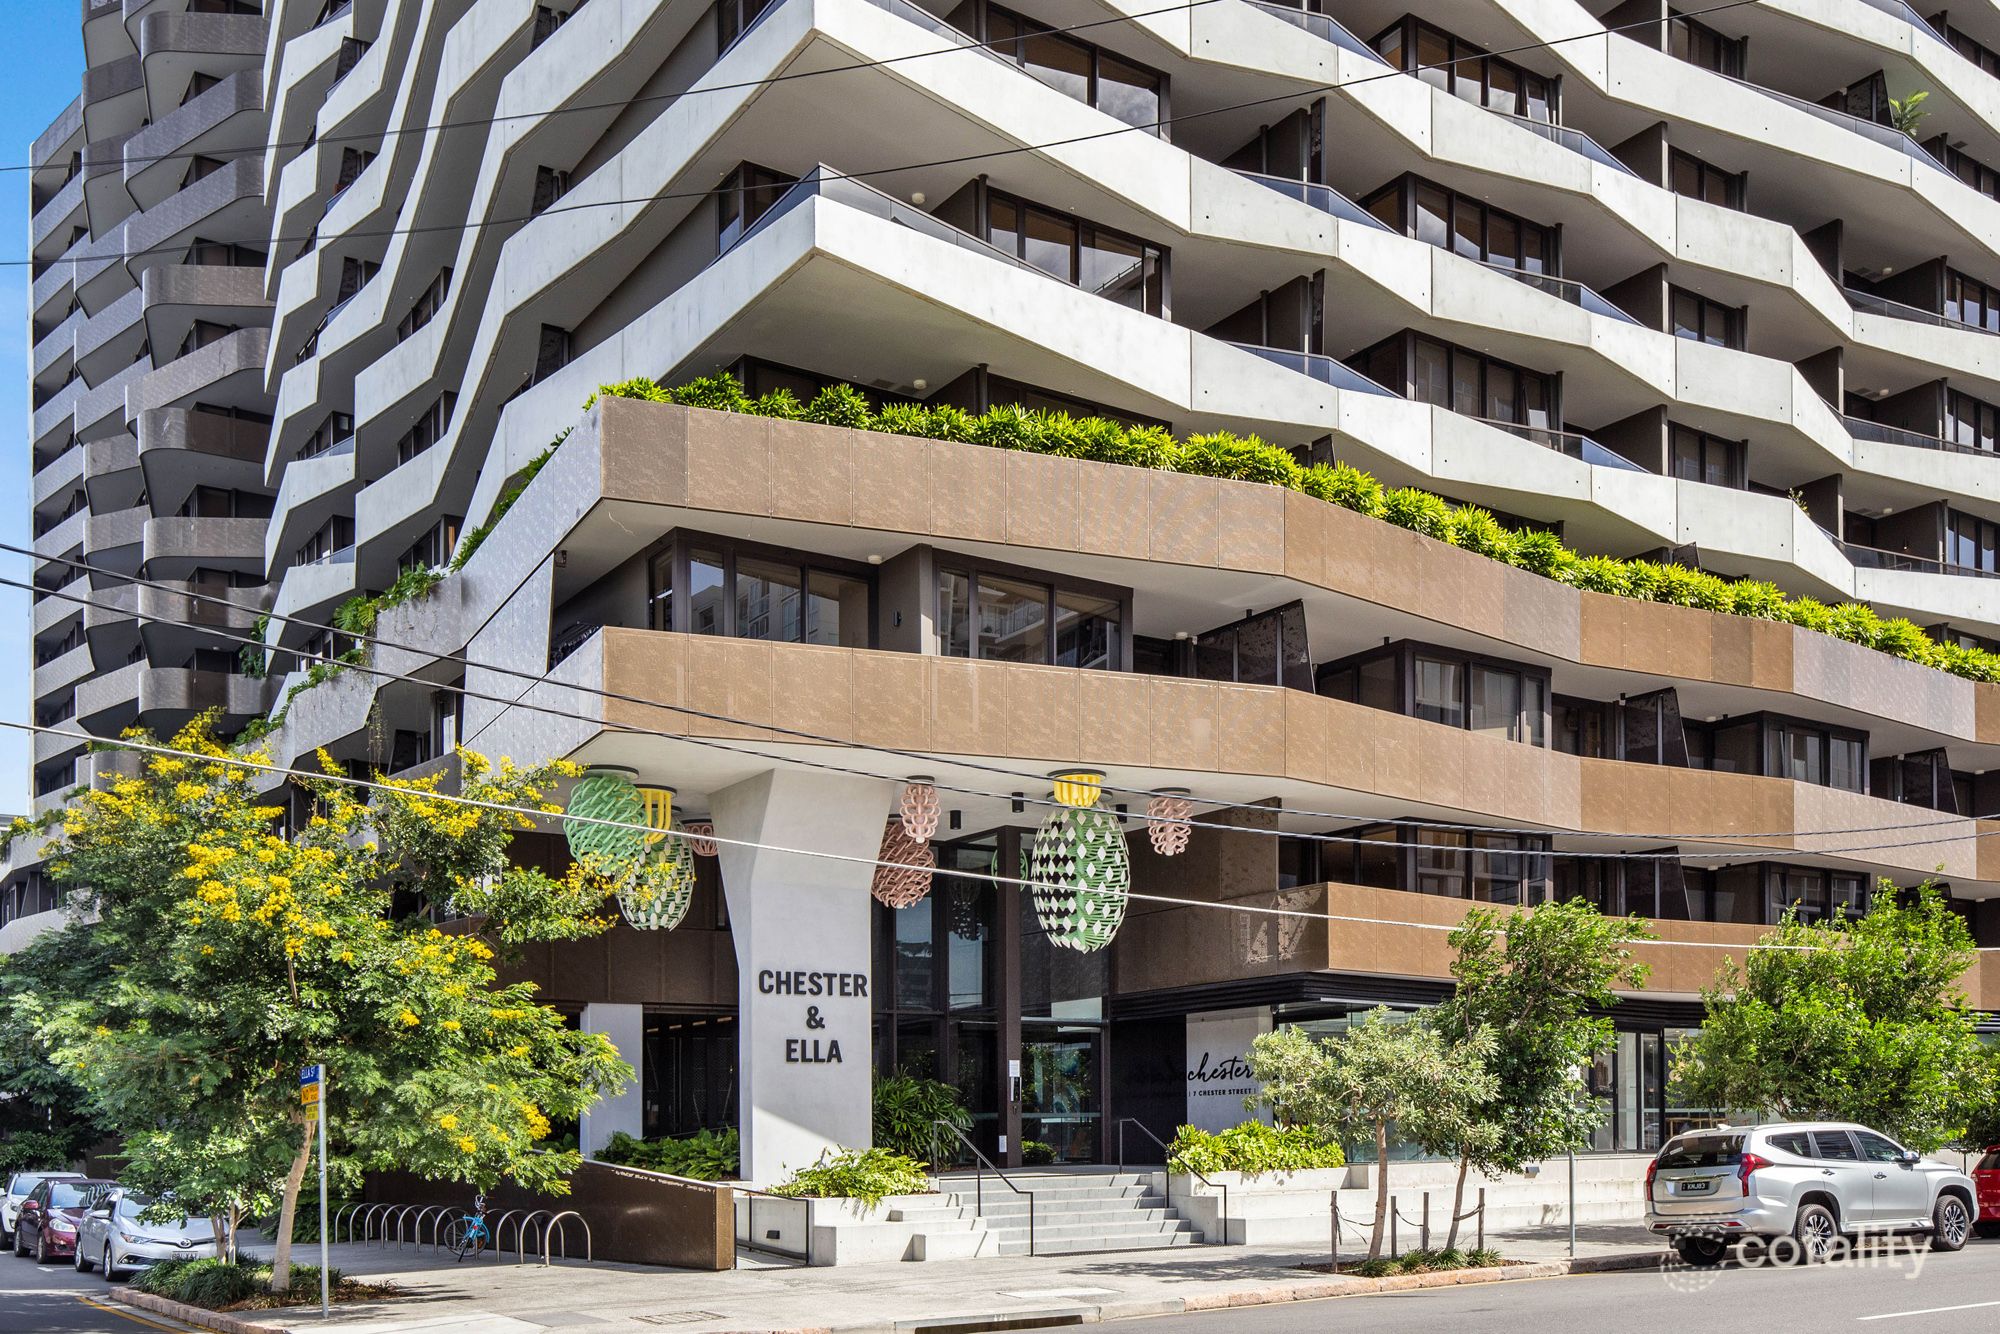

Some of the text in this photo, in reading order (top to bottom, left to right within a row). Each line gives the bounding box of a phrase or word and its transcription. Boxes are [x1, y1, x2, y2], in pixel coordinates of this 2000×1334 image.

[758, 969, 868, 997] CHESTER
[805, 1005, 826, 1030] &
[785, 1038, 843, 1063] ELLA
[1187, 1051, 1254, 1083] chester
[1198, 1088, 1226, 1097] CHESTER
[1228, 1087, 1252, 1096] STREET
